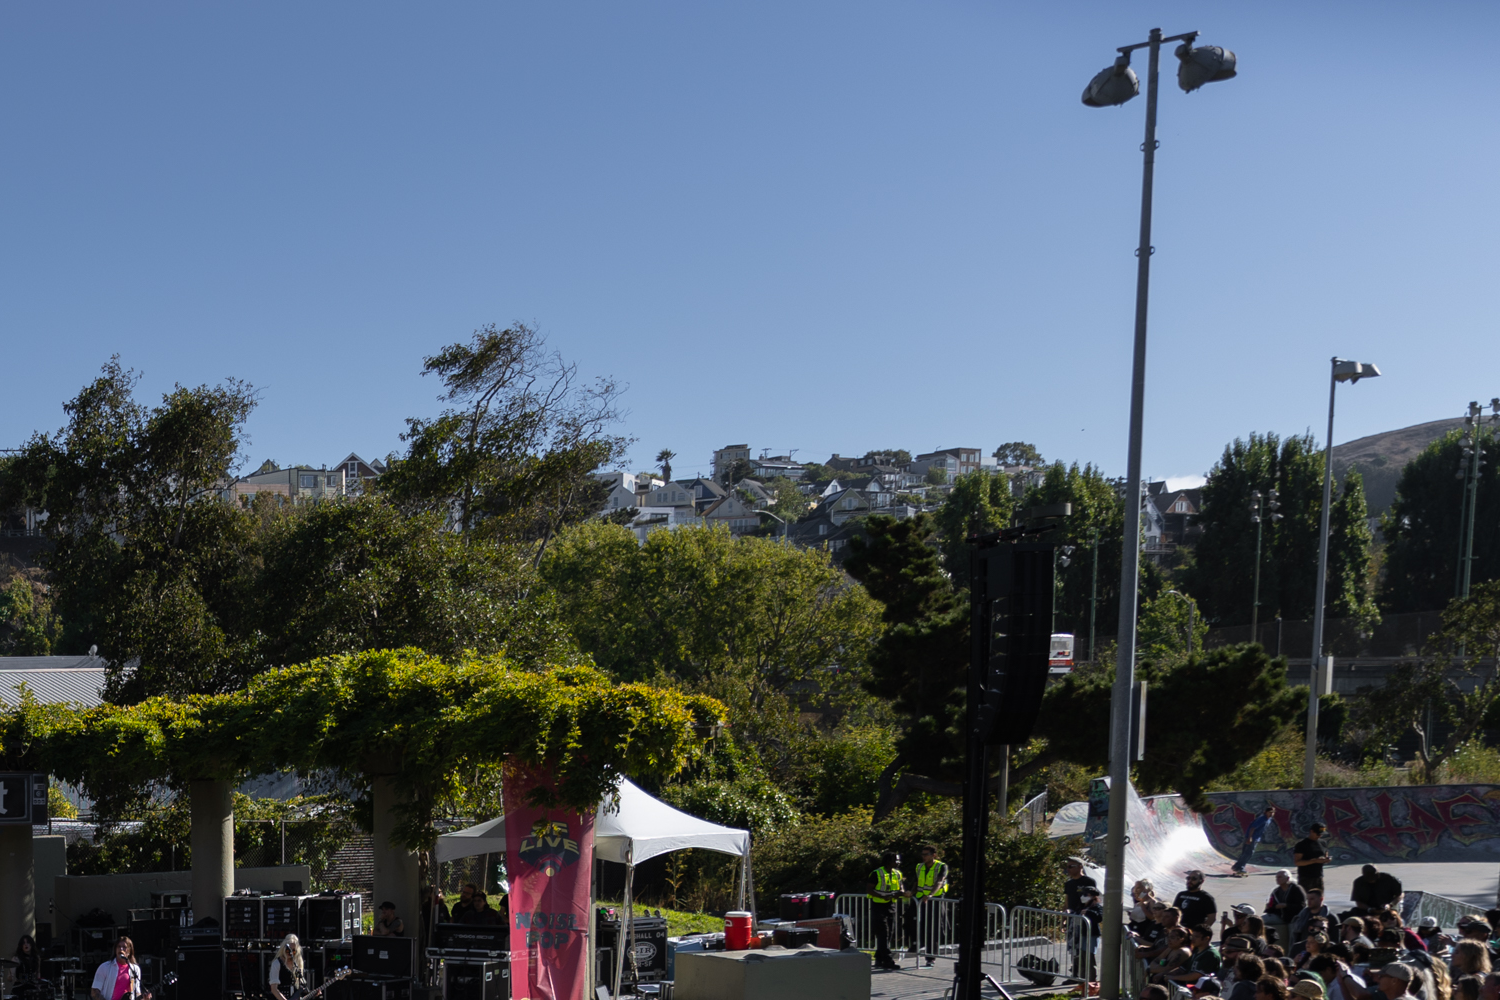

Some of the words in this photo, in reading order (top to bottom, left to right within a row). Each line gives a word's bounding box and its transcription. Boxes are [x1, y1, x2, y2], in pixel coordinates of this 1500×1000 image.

[519, 836, 580, 856] LIVE
[515, 912, 578, 930] NOISE
[526, 931, 569, 949] POP
